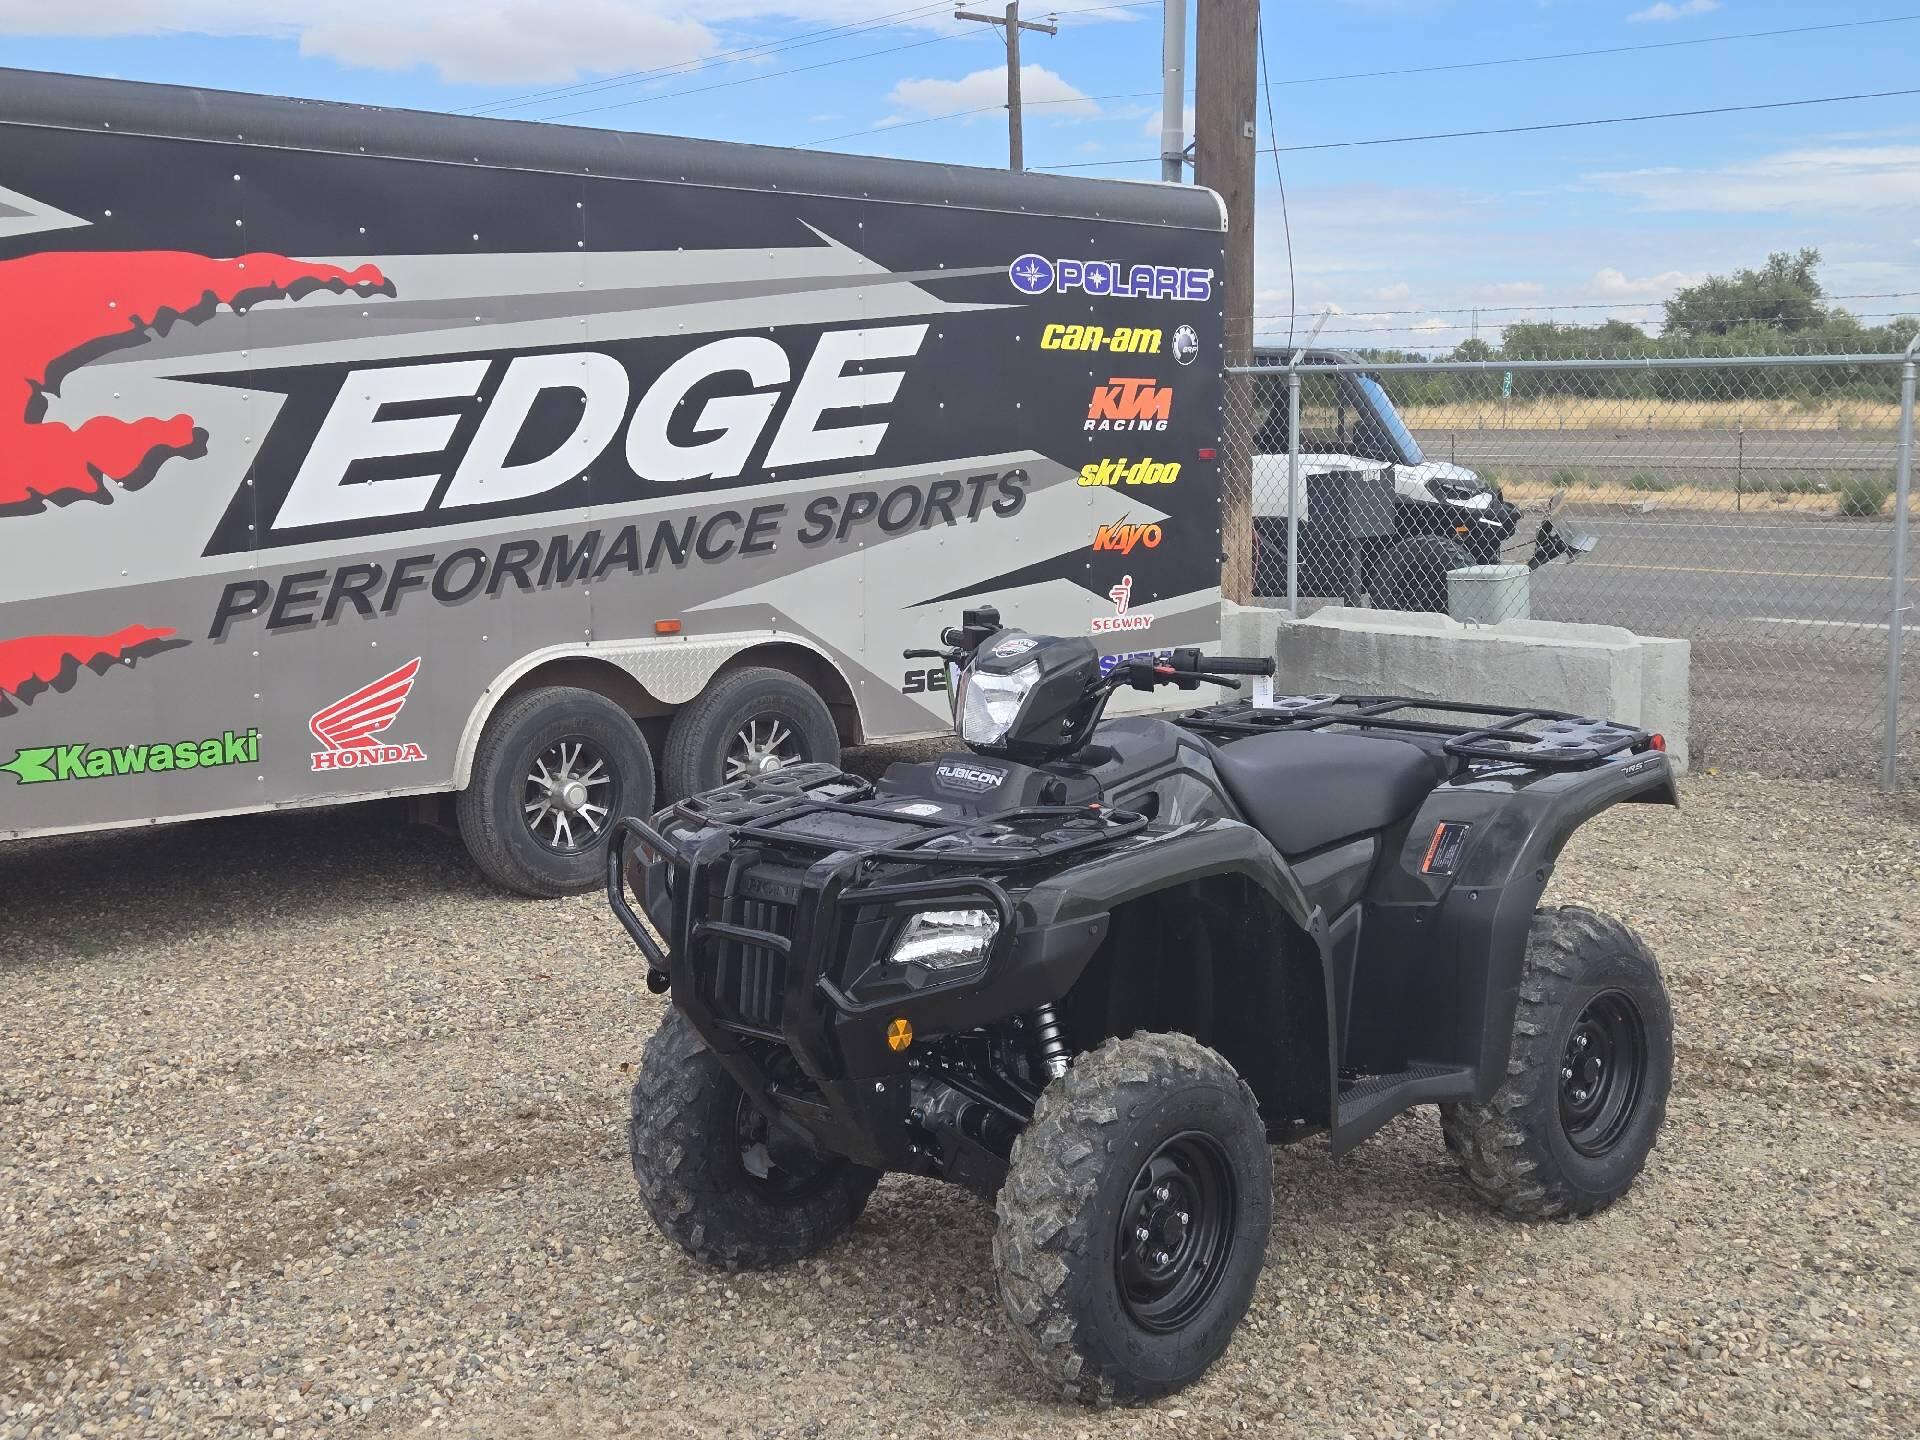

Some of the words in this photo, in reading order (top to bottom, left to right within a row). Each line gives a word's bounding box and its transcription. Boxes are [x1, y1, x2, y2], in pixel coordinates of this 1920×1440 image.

[1056, 259, 1213, 301] POLARIS
[1087, 377, 1173, 420] KTM
[270, 324, 930, 530] EDGE
[1083, 419, 1169, 431] RACING
[1077, 458, 1182, 487] ski-doo
[208, 503, 788, 641] PERFORMANCE
[798, 468, 1029, 545] SPORTS
[1093, 513, 1163, 555] KAYO
[1092, 616, 1153, 631] SEGWAY
[56, 727, 260, 781] Kawasaki
[310, 742, 428, 771] HONDA
[935, 766, 1003, 786] RUBICON
